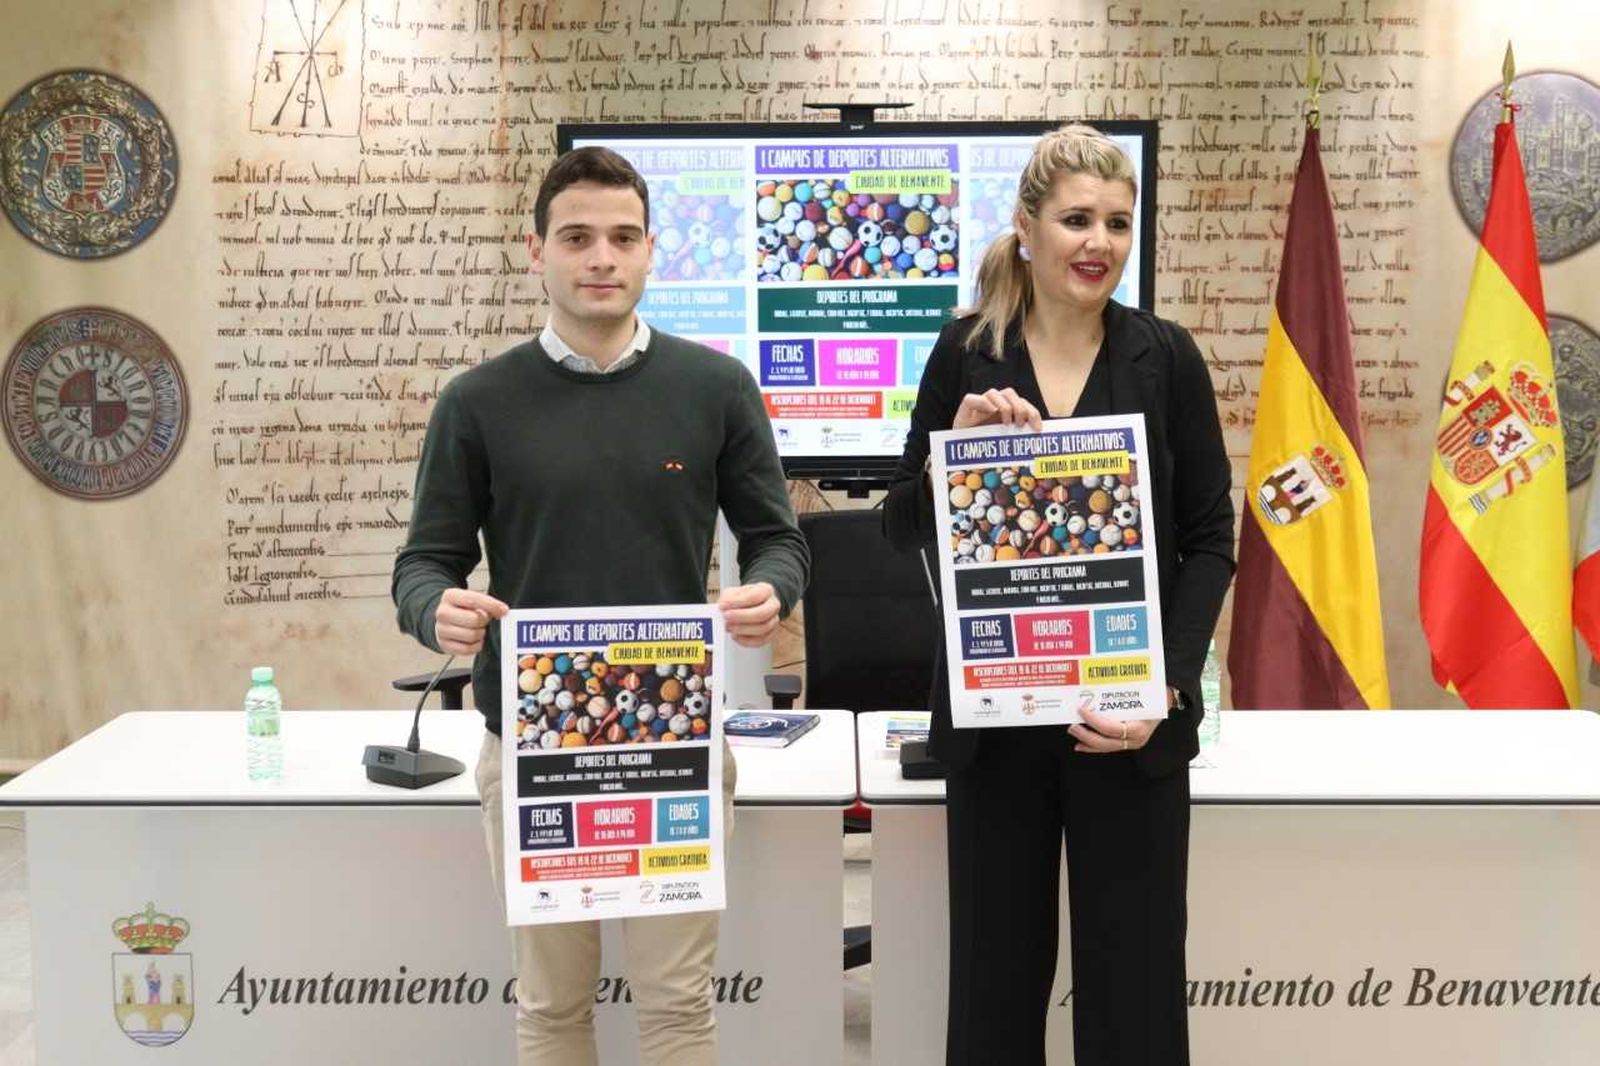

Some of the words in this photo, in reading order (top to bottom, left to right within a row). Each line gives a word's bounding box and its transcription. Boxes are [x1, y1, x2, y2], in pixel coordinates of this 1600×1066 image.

[768, 149, 811, 168] CAMPUS
[813, 149, 826, 168] DE
[828, 149, 877, 168] DEPORTES
[879, 148, 949, 168] ALTERNATIVOS
[855, 175, 885, 189] CIUDAD
[888, 175, 897, 188] DE
[899, 174, 945, 188] BENAVENTE
[772, 344, 804, 363] FECHAS
[957, 440, 997, 460] CAMPUS
[1000, 439, 1011, 457] DE
[1013, 436, 1059, 457] DEPORTES
[1061, 431, 1126, 453] ALTERNATIVOS
[1040, 460, 1068, 474] CIUDAD
[1070, 459, 1079, 471] DE
[1081, 456, 1123, 471] BENAVENTE
[530, 623, 571, 642] CAMPUS
[573, 623, 586, 641] DE
[588, 622, 635, 642] DEPORTES
[637, 621, 703, 641] ALTERNATIVOS
[971, 619, 1002, 638] FECHAS
[1032, 618, 1073, 638] HORARIOS
[1105, 613, 1137, 632] EDADES
[614, 646, 642, 660] CIUDAD
[645, 646, 654, 660] DE
[656, 645, 699, 660] BENAVENTE
[1099, 700, 1144, 711] ZAMORA
[531, 808, 563, 827] FECHAS
[594, 806, 636, 826] HORARIOS
[669, 803, 699, 821] EDADES
[659, 891, 702, 903] ZAMORA
[218, 966, 490, 1015] Ayuntamiento
[1347, 967, 1393, 1008] de
